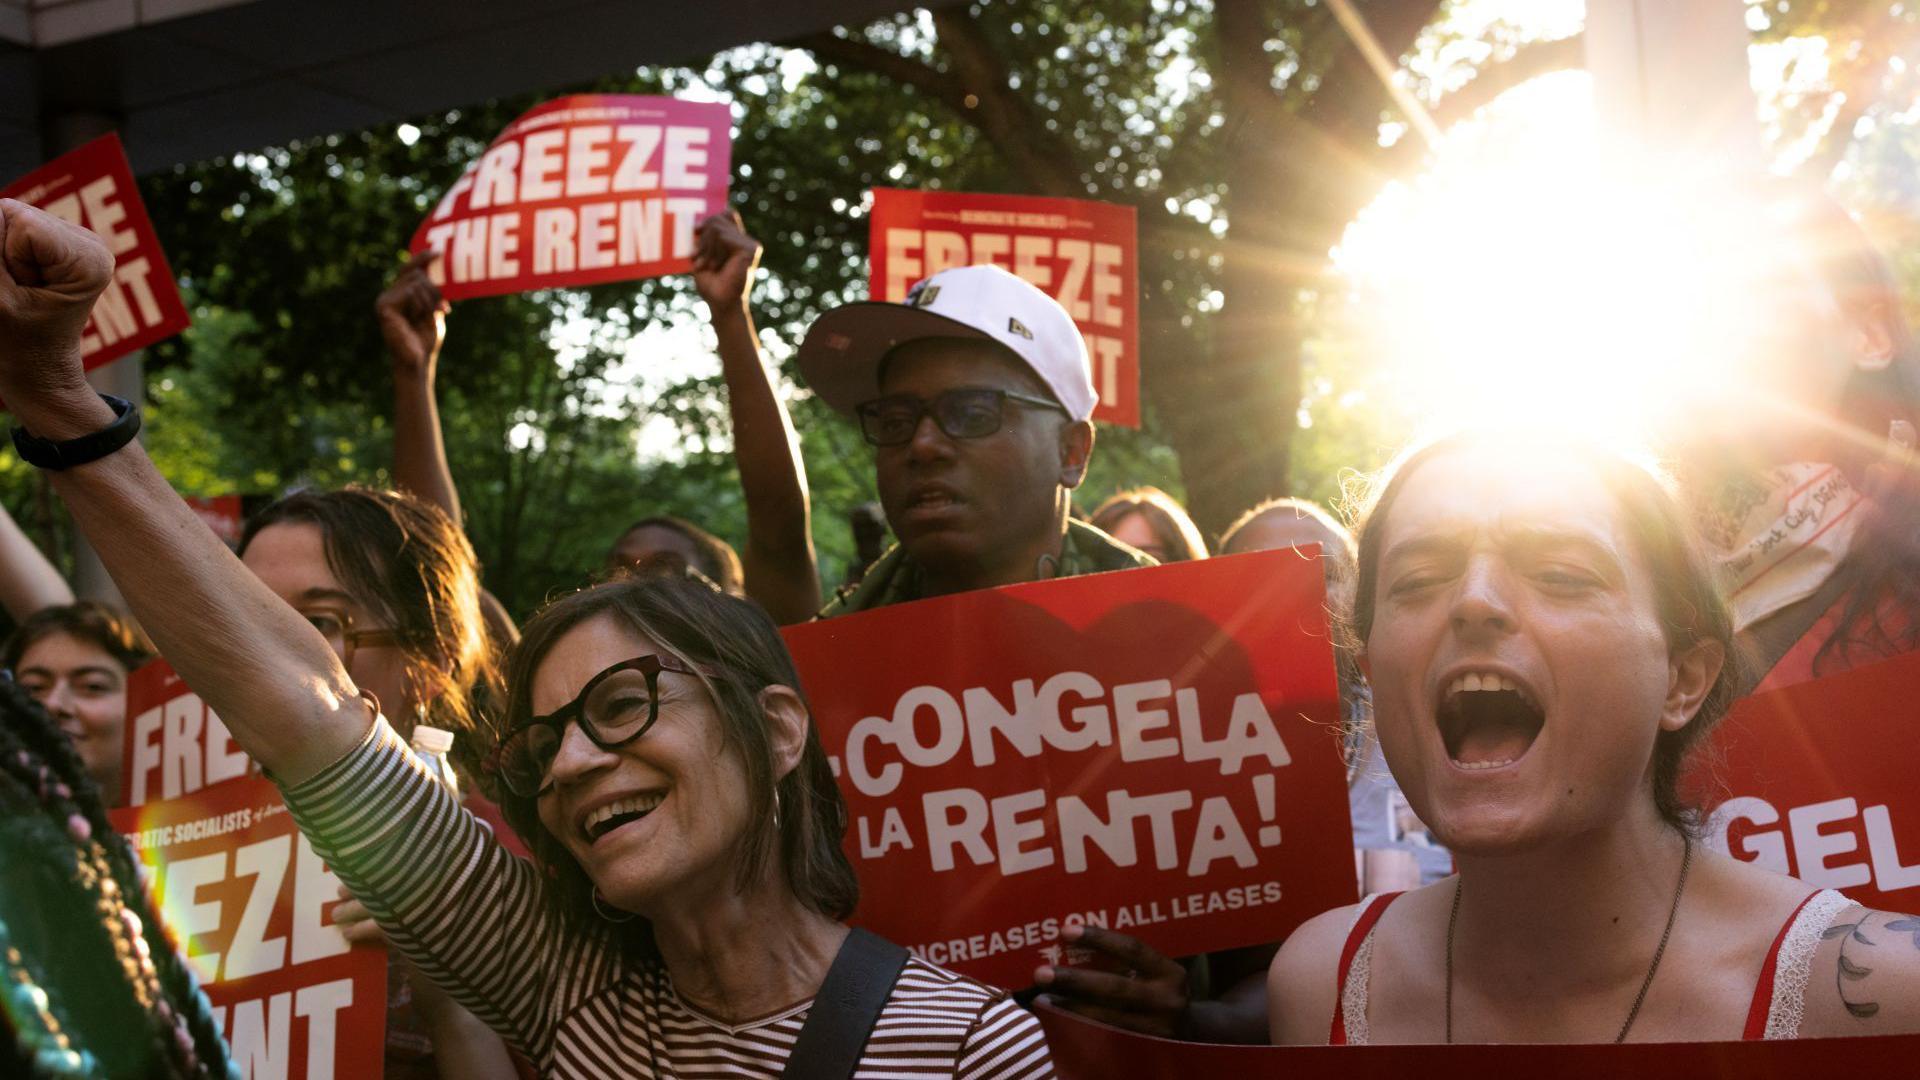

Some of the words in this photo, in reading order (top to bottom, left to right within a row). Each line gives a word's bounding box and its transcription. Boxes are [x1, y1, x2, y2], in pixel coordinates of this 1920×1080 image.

[433, 125, 711, 221] FREEZE
[426, 212, 520, 286] THE
[532, 198, 707, 275] RENT
[130, 692, 262, 808] FRE
[174, 808, 252, 844] SOCIALISTS
[857, 807, 914, 859] LA
[922, 774, 1282, 877] RENTA!
[139, 830, 353, 985] EZE
[906, 918, 1060, 966] NCREASES
[1115, 902, 1168, 929] ALL
[1171, 881, 1283, 919] LEASES
[211, 978, 354, 1080] NT
